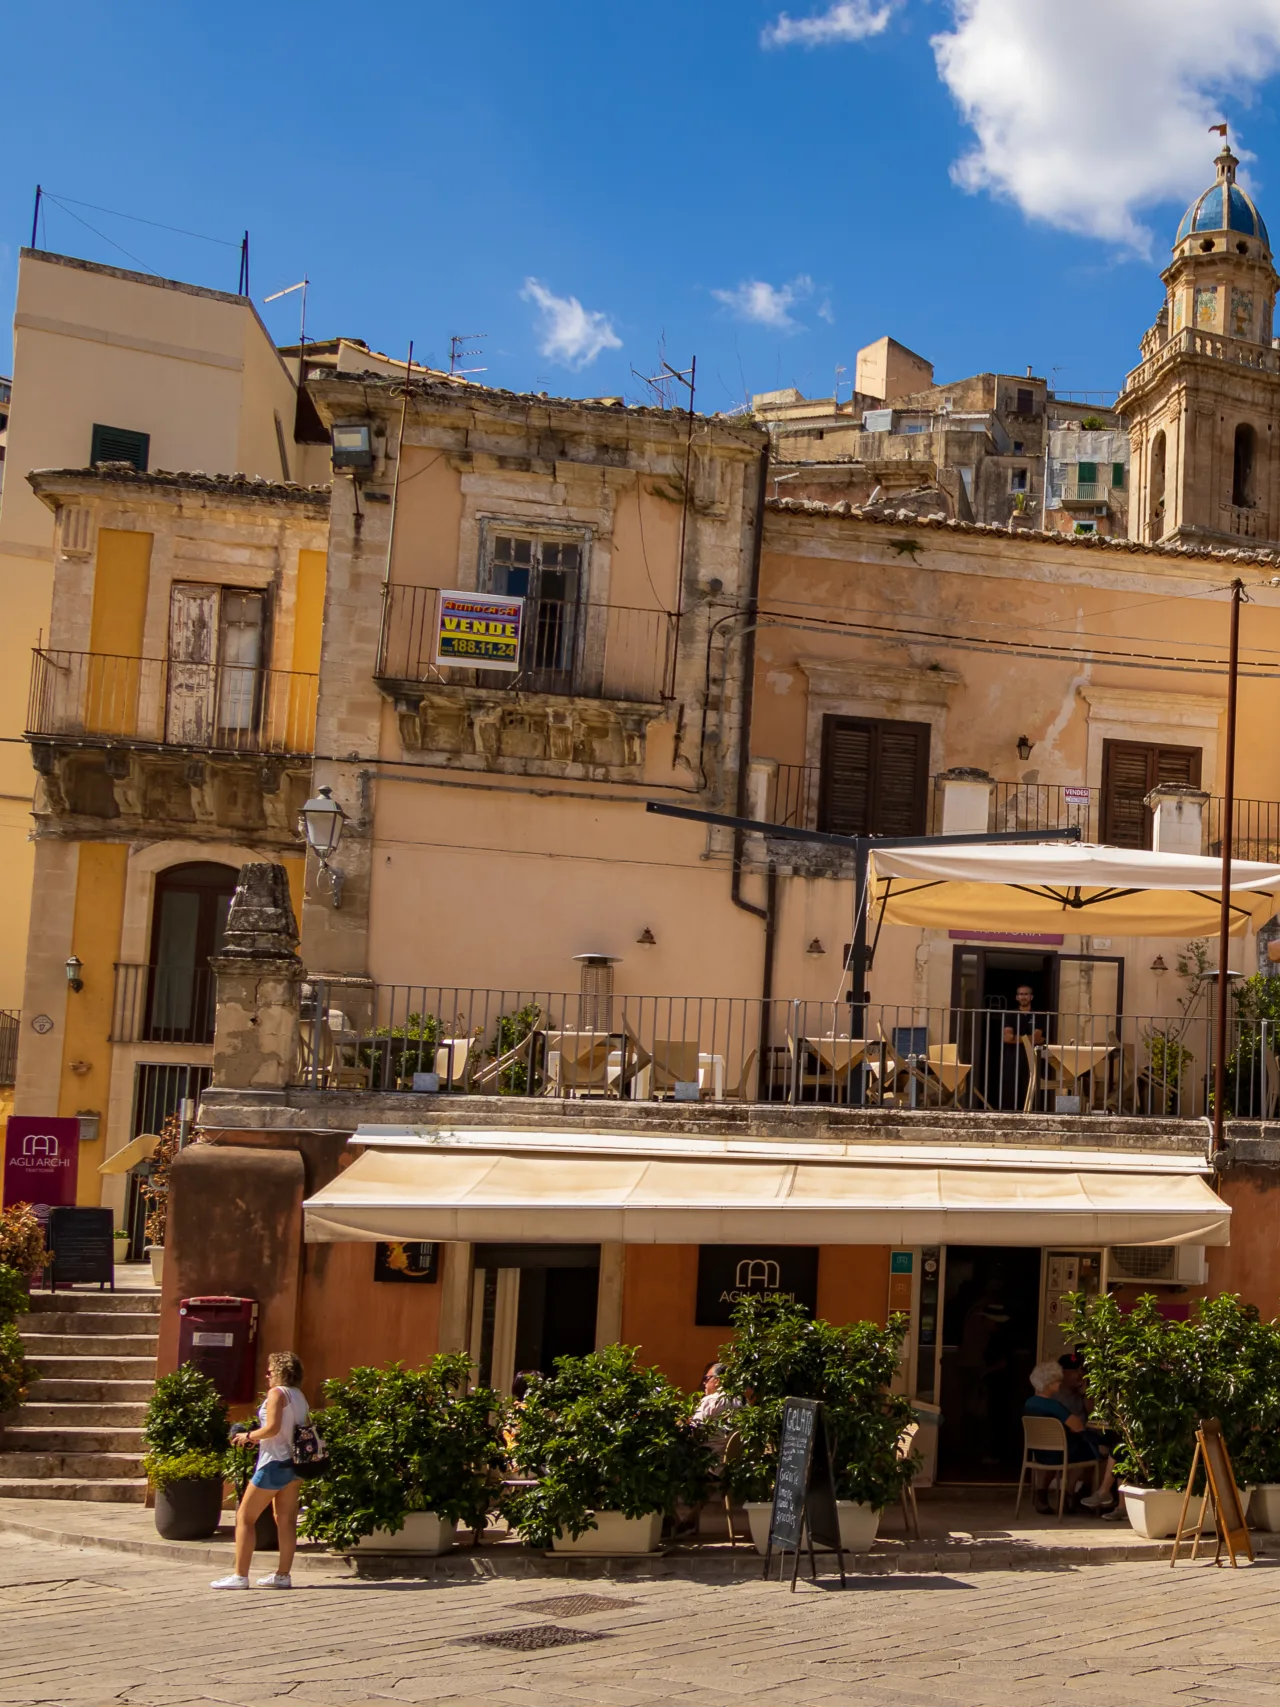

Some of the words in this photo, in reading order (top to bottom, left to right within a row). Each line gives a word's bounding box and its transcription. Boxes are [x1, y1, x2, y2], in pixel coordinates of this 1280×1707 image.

[444, 617, 515, 637] VENDE
[452, 639, 515, 656] 188.11.24
[9, 1157, 35, 1167] AGLI
[36, 1158, 70, 1167] ARCHI
